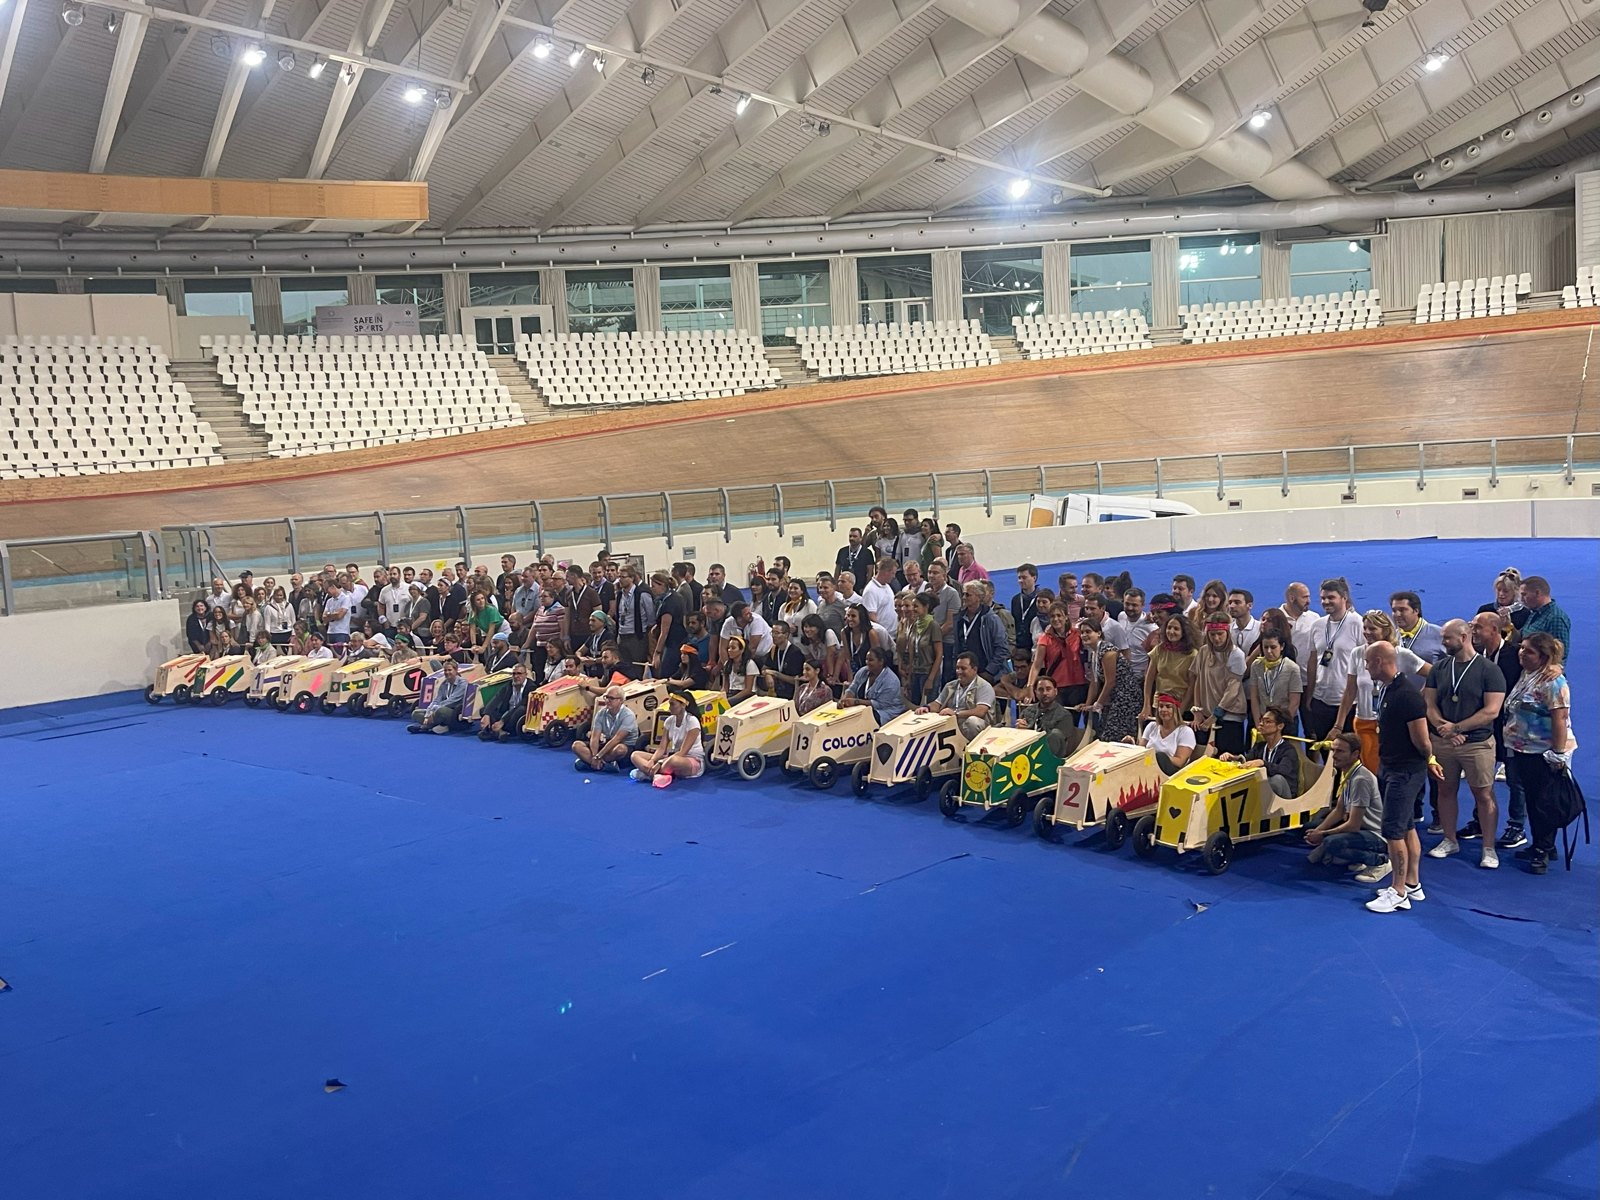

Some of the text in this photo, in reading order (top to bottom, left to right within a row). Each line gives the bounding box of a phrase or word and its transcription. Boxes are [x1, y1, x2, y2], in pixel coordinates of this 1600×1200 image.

[354, 316, 373, 325] SAFE
[374, 316, 383, 324] IN
[254, 672, 261, 690] 1
[409, 670, 422, 691] 7
[796, 733, 809, 751] 13
[822, 728, 880, 752] COLOCA
[937, 728, 957, 765] 5
[1063, 782, 1080, 808] 2
[1220, 788, 1249, 832] 17
